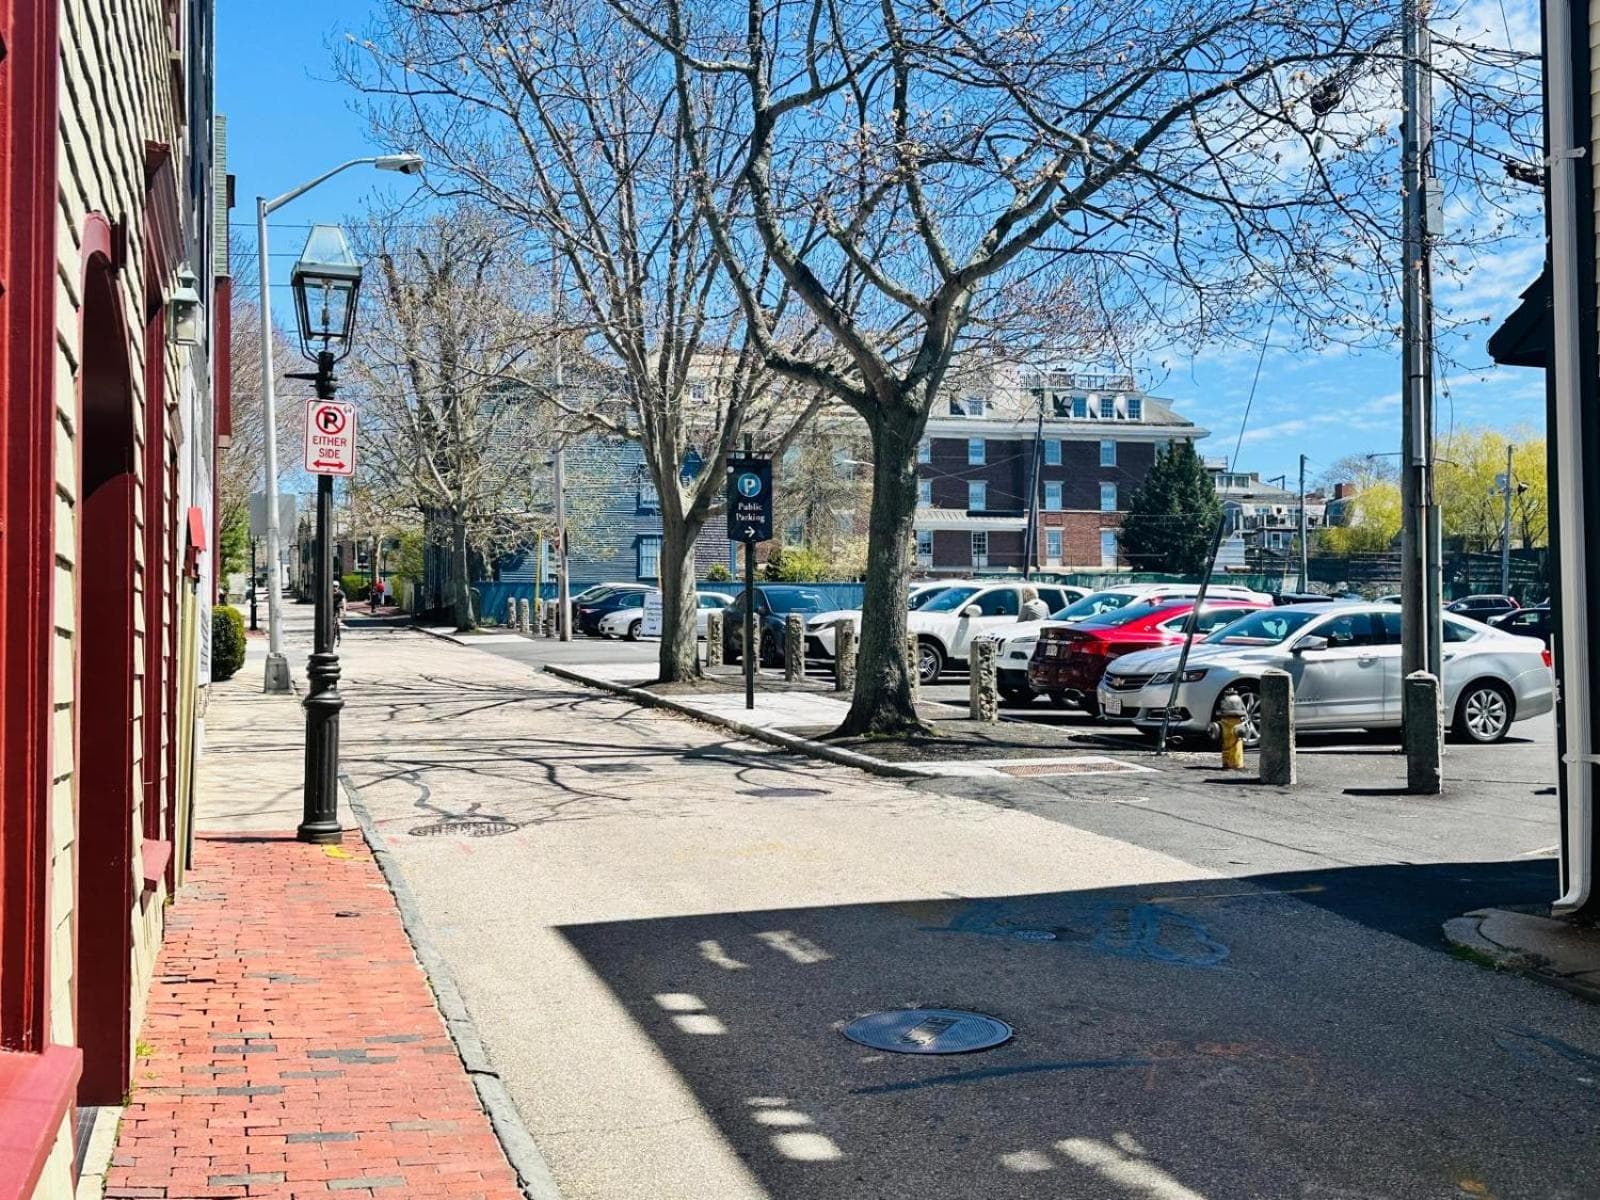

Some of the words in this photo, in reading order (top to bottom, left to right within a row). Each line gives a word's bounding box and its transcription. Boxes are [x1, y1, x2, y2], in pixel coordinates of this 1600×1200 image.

[312, 436, 347, 446] EITHER
[319, 448, 341, 458] SIDE
[744, 478, 756, 496] P
[738, 502, 762, 510] Public
[736, 512, 765, 524] Parking
